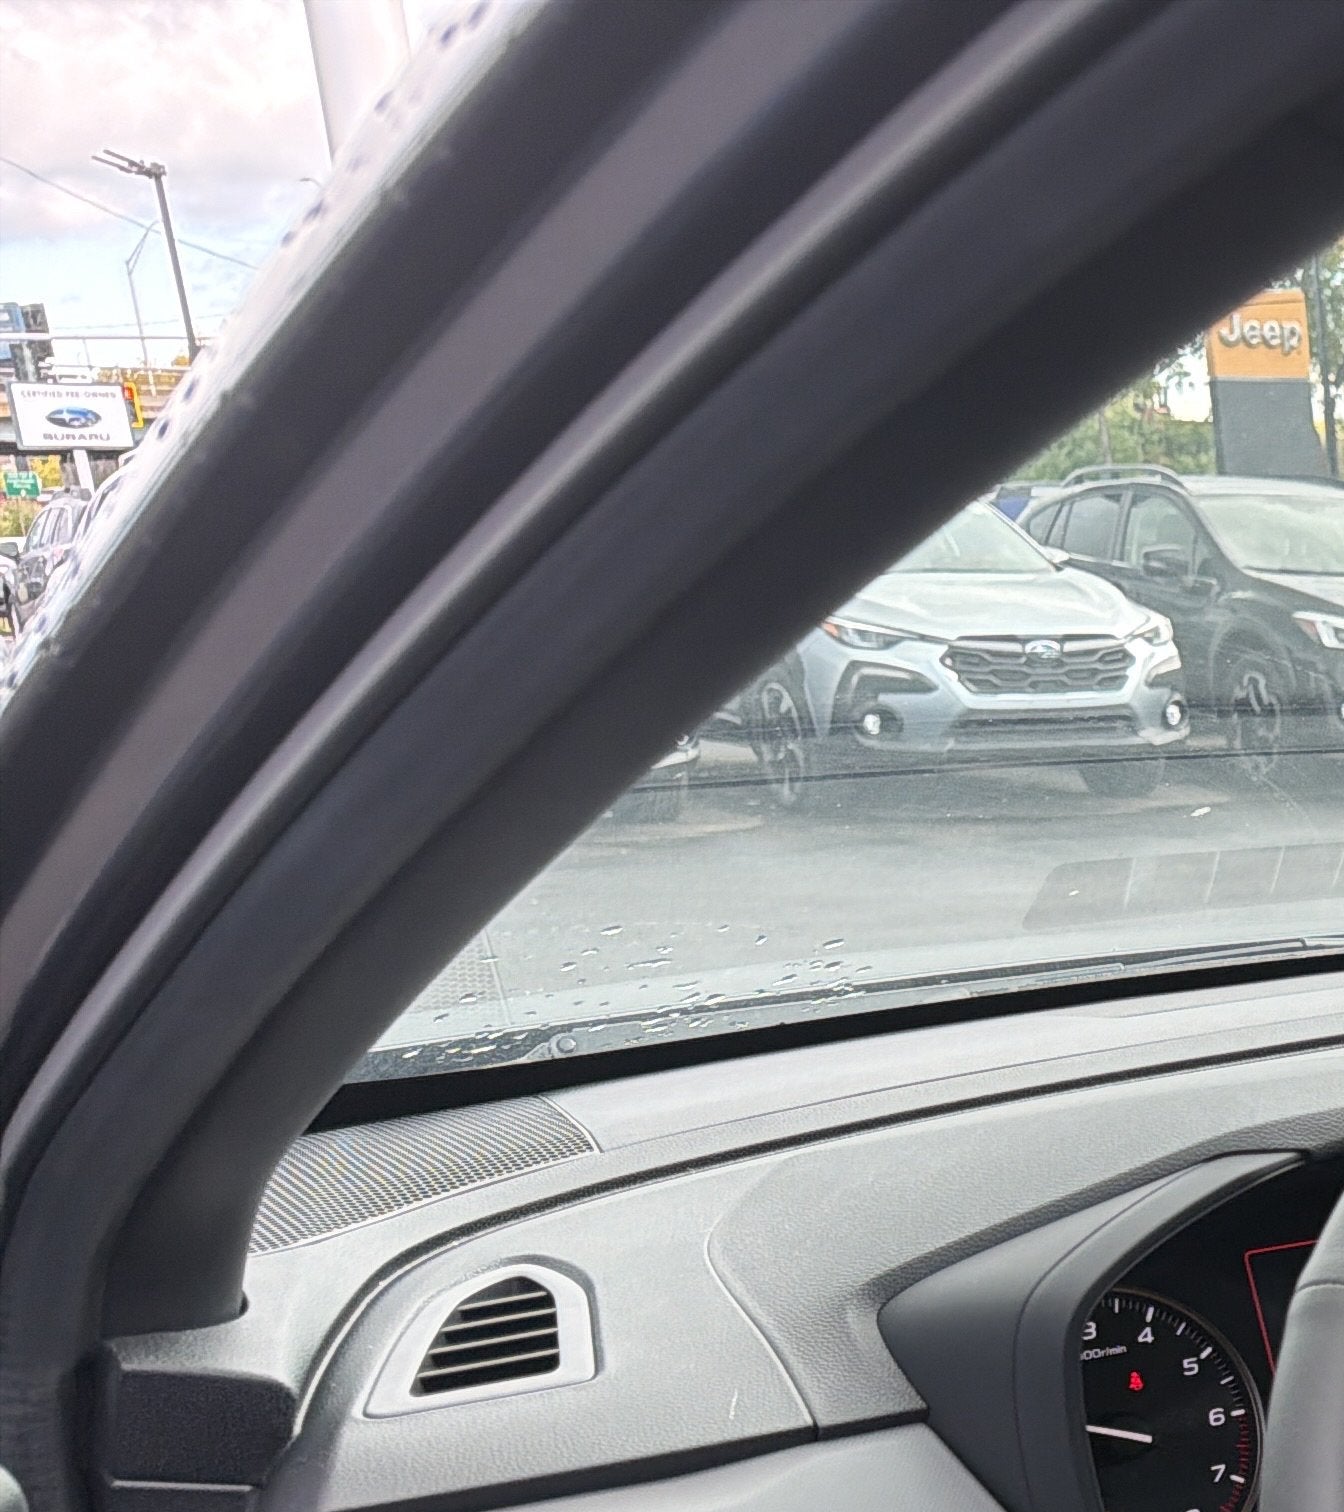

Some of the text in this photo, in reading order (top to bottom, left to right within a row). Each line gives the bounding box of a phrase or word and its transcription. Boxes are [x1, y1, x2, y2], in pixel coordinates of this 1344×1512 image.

[1219, 312, 1302, 356] Jeep
[43, 433, 111, 441] SUBARU
[1081, 1321, 1097, 1340] 3
[1137, 1326, 1154, 1343] 4
[1182, 1358, 1199, 1375] 5
[1208, 1407, 1226, 1426] 6
[1211, 1464, 1226, 1482] 7
